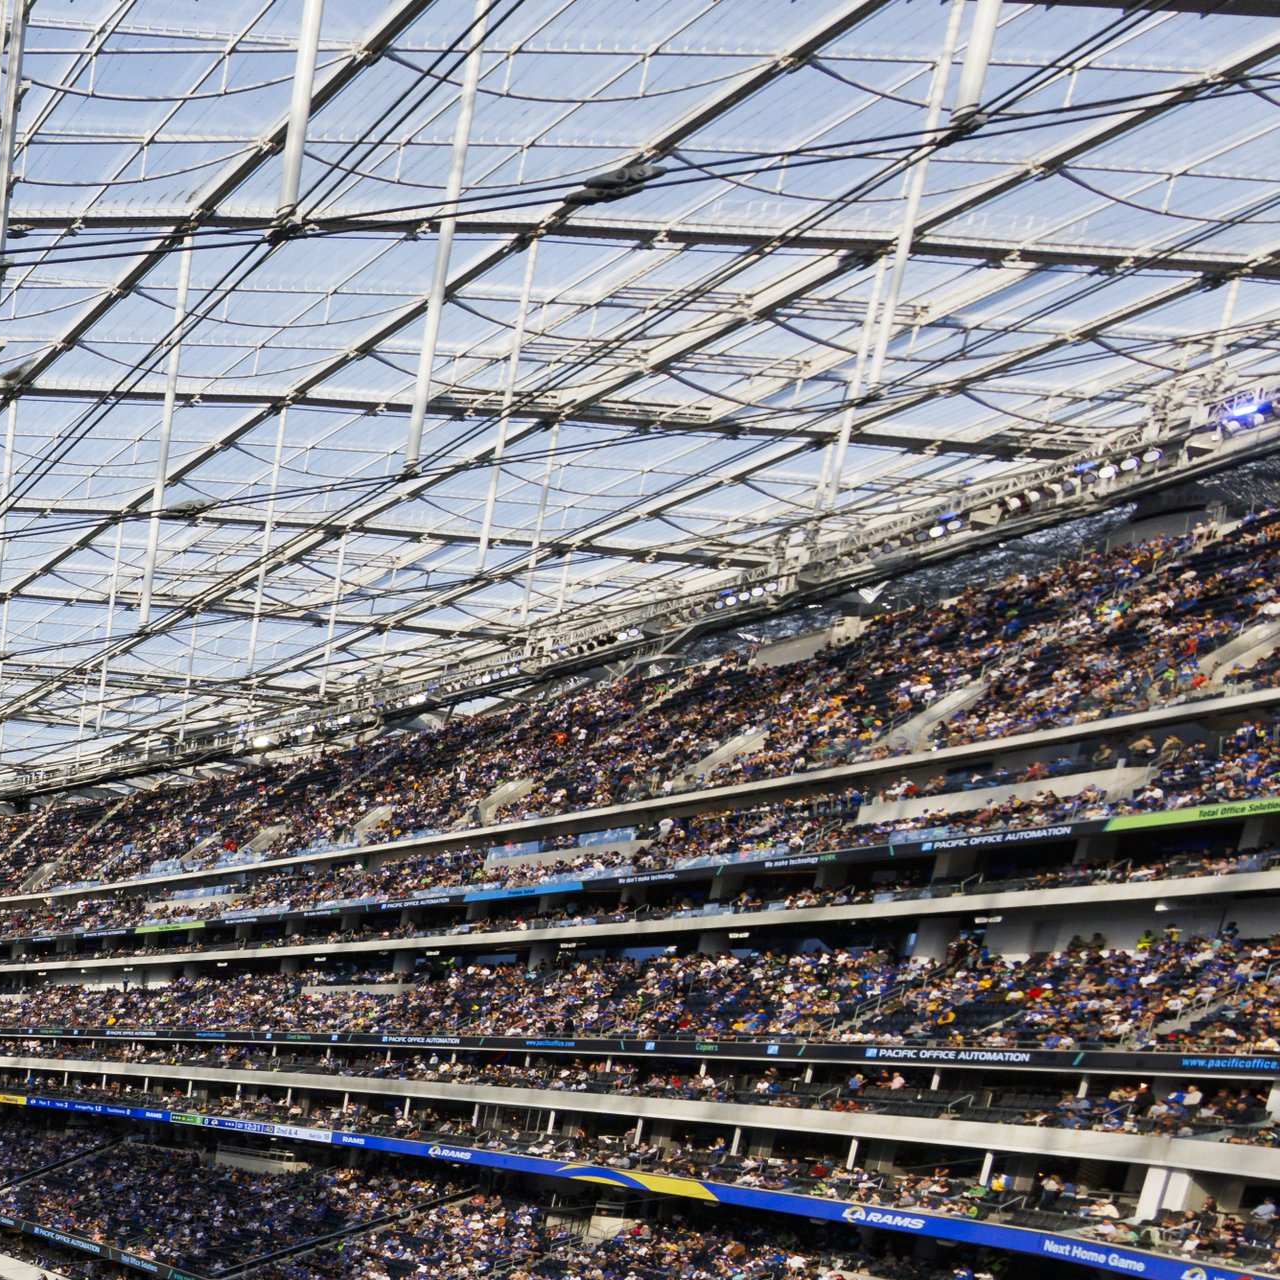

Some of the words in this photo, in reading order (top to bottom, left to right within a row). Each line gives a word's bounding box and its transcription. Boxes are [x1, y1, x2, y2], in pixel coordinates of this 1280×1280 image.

[1199, 808, 1219, 818] Total
[1220, 805, 1245, 815] Office
[934, 837, 968, 849] PACIFIC
[970, 834, 1002, 845] OFFICE
[1005, 826, 1072, 842] AUTOMATION
[879, 1049, 916, 1058] PACIFIC
[919, 1050, 955, 1059] OFFICE
[958, 1051, 1029, 1062] AUTOMATION
[343, 1136, 365, 1145] RAMS
[441, 1149, 472, 1160] RAMS
[866, 1212, 925, 1229] RAMS
[1044, 1239, 1071, 1256] Next
[1071, 1245, 1106, 1264] Home
[1107, 1253, 1145, 1272] Game
